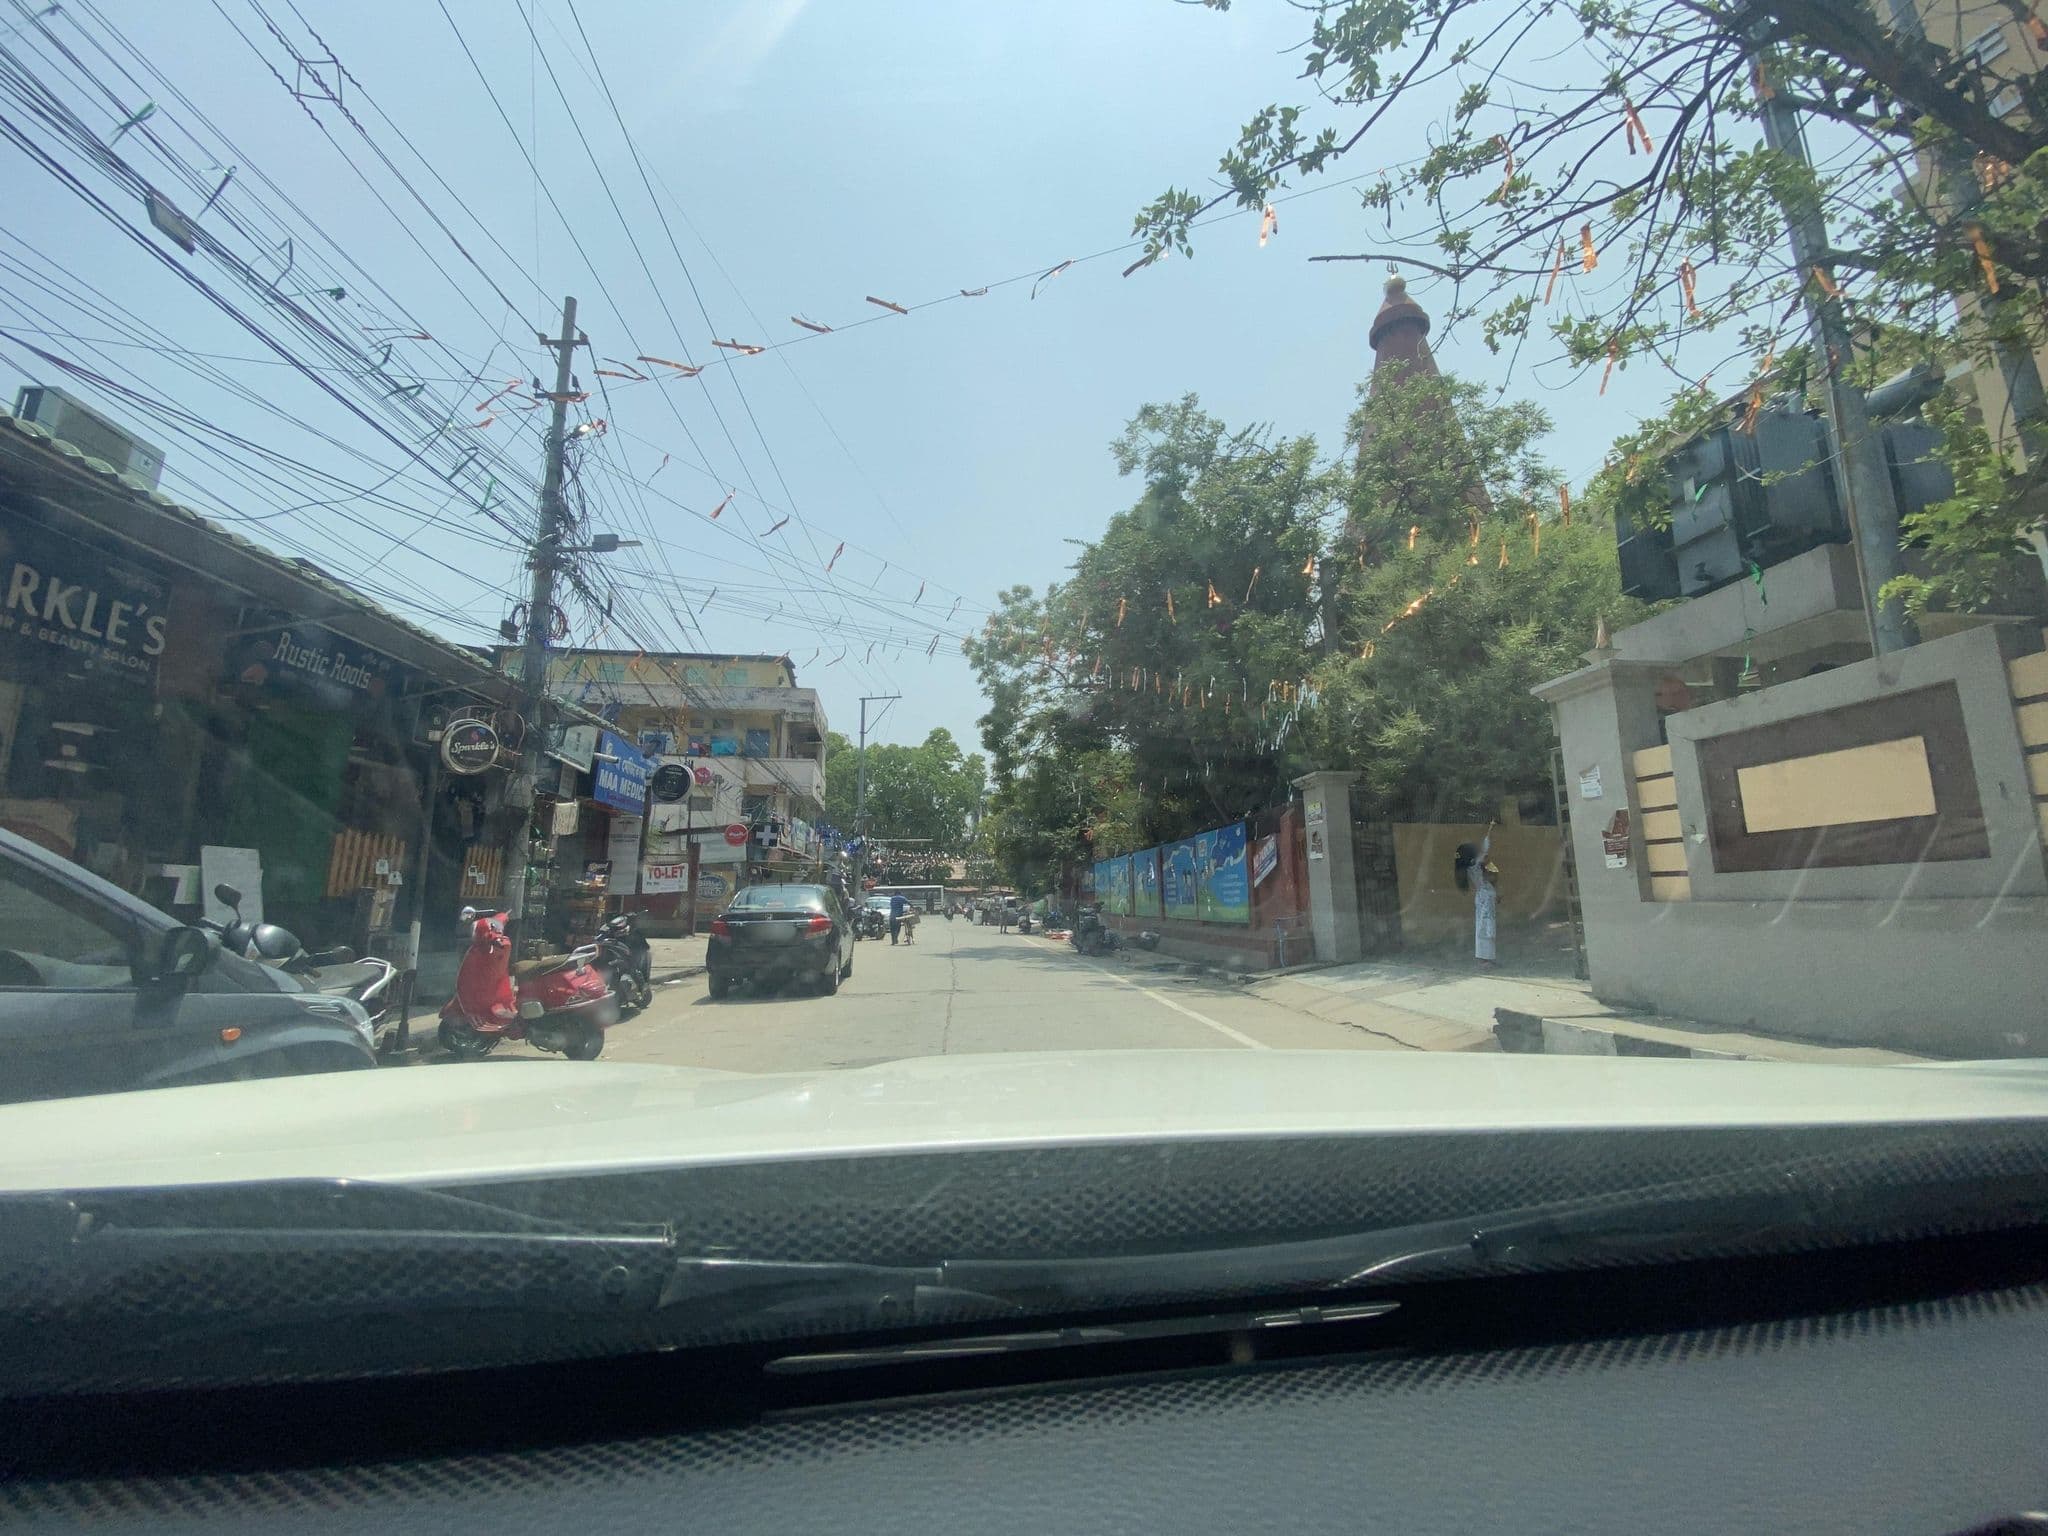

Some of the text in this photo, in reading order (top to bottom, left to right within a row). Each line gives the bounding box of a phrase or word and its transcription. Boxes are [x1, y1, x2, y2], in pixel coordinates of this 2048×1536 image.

[19, 622, 32, 636] &
[38, 627, 98, 655] BEAUTY
[102, 647, 150, 672] SALON
[272, 631, 329, 675] Rustic
[329, 651, 372, 689] Roots
[450, 740, 495, 755] Sparkle's
[598, 768, 618, 792] MAA
[646, 864, 685, 881] TO-LET
